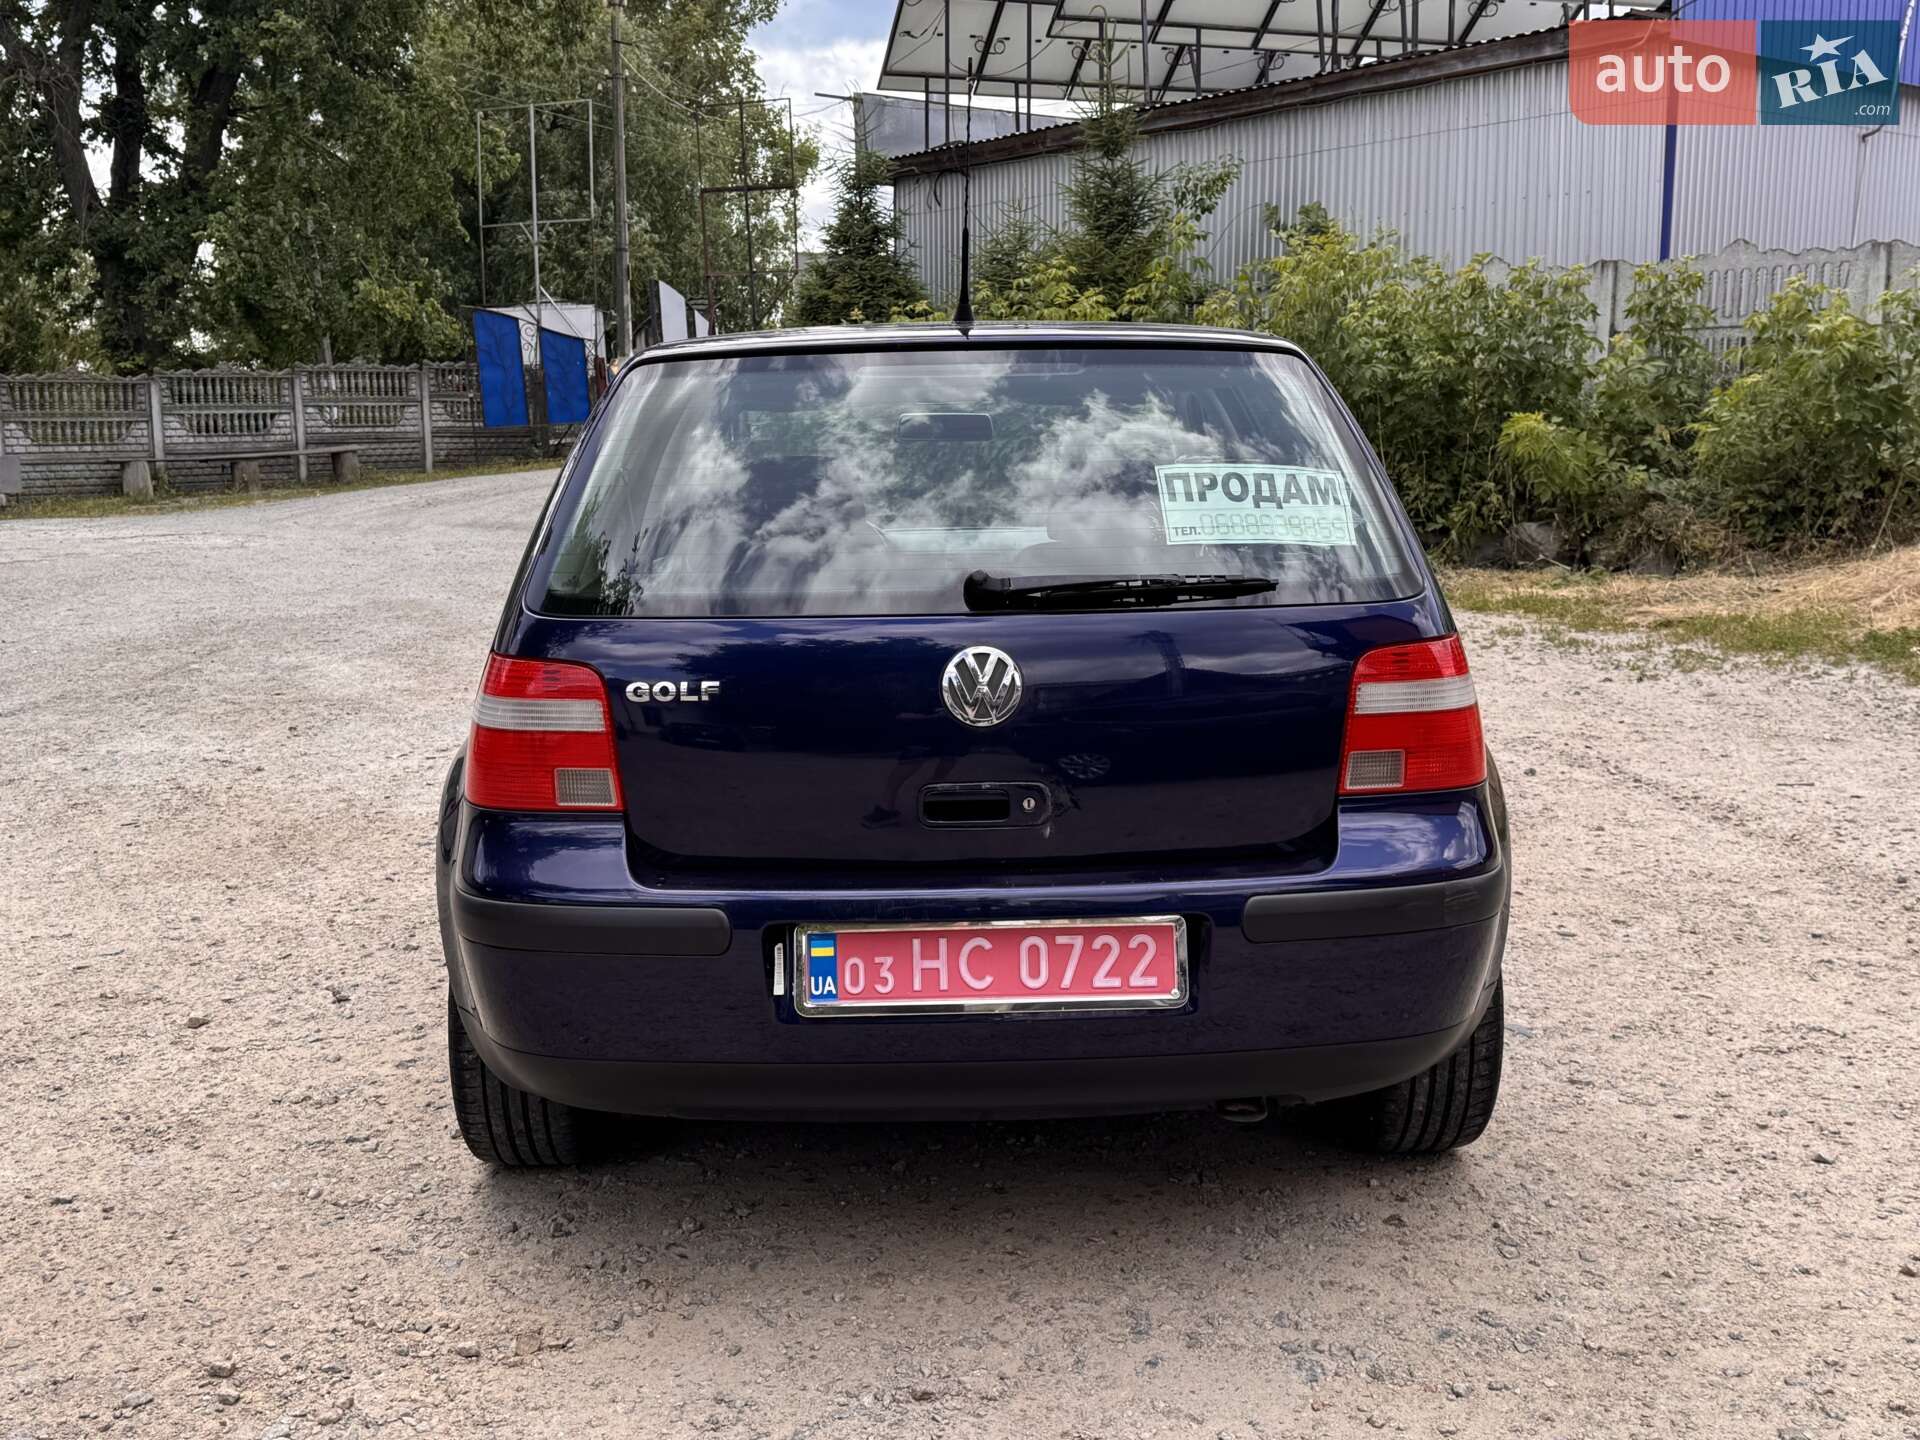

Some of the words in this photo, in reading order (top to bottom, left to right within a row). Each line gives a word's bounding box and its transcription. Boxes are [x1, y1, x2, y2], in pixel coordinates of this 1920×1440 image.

[1164, 471, 1341, 510] ПРОДАМ
[625, 681, 721, 703] GOLF
[843, 956, 896, 995] 03
[911, 936, 995, 992] HC
[1019, 933, 1159, 989] 0722
[810, 975, 837, 996] UA
